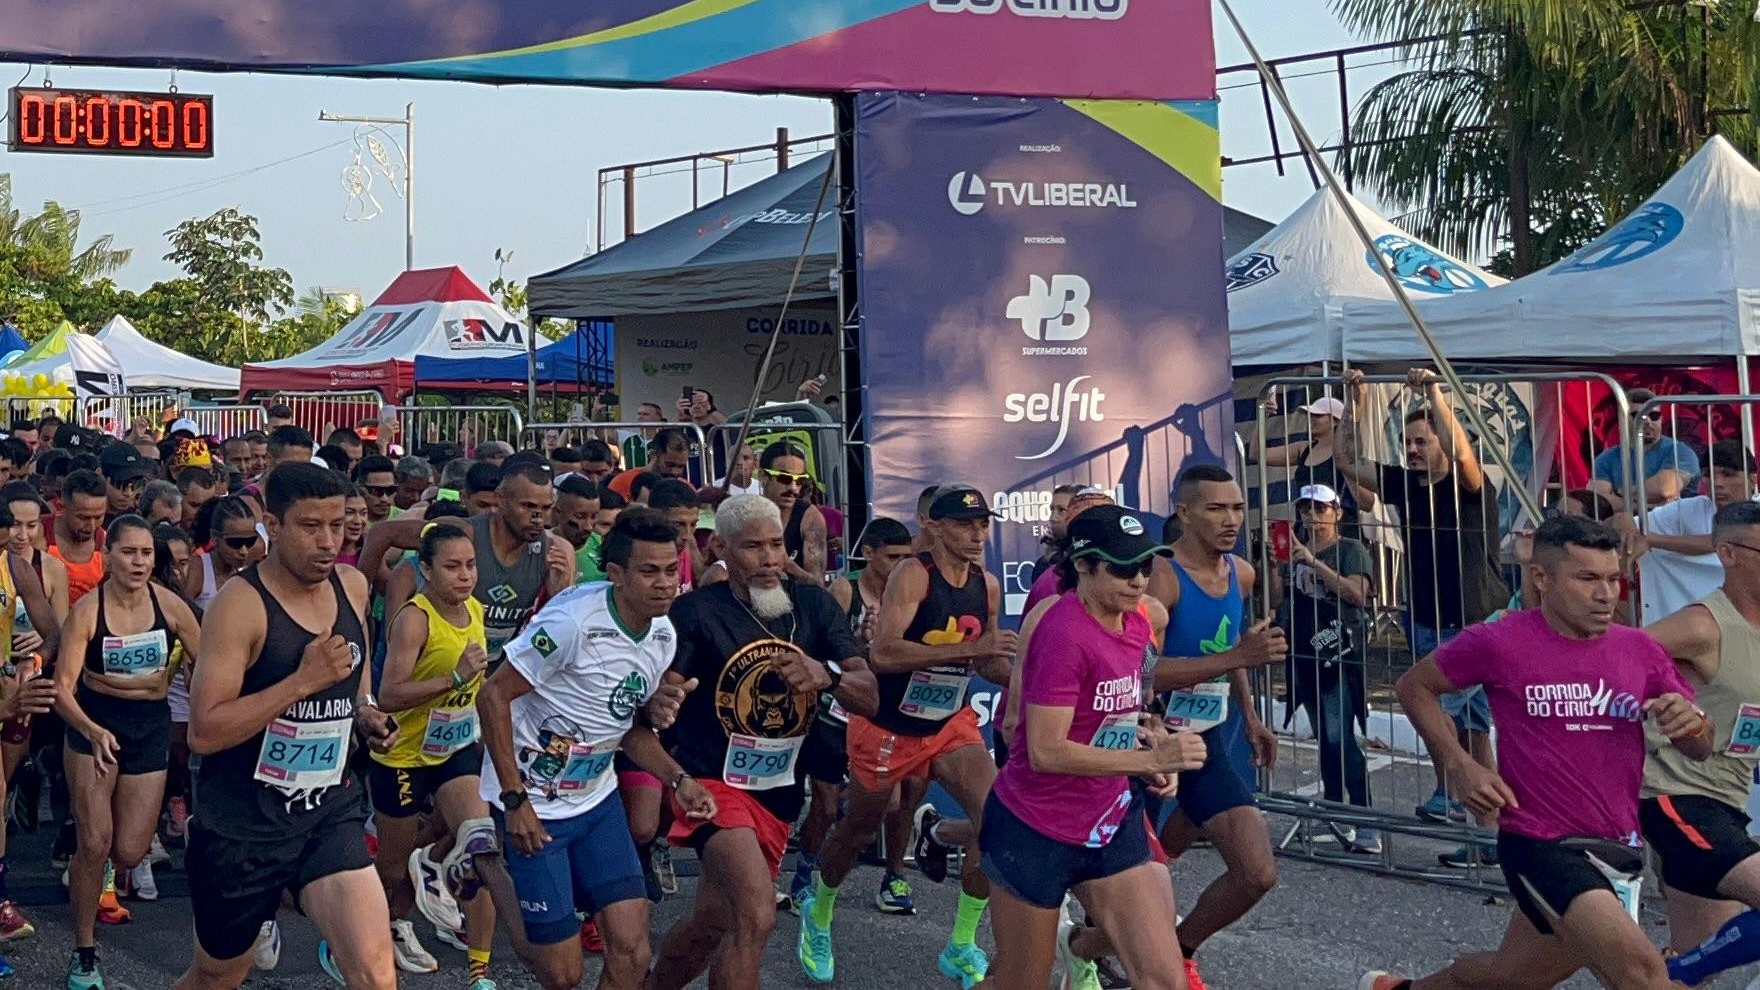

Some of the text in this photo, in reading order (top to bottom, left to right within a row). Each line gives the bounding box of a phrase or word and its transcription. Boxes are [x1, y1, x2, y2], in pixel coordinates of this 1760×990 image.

[20, 95, 207, 149] 00:00:00
[746, 317, 834, 337] CORRIDA
[1021, 346, 1088, 356] SUPERMERCADOS
[1002, 374, 1106, 460] selfit
[108, 647, 157, 666] 8658
[909, 685, 955, 706] 8029
[1525, 683, 1592, 701] CORRIDA
[285, 696, 353, 720] AVALARIA
[1093, 695, 1114, 712] DO
[1172, 696, 1220, 717] 7197
[1527, 701, 1551, 718] DO
[429, 721, 471, 741] 4610
[1094, 730, 1134, 750] 428
[268, 741, 335, 765] 8714
[732, 751, 789, 773] 8790
[566, 756, 608, 776] 716
